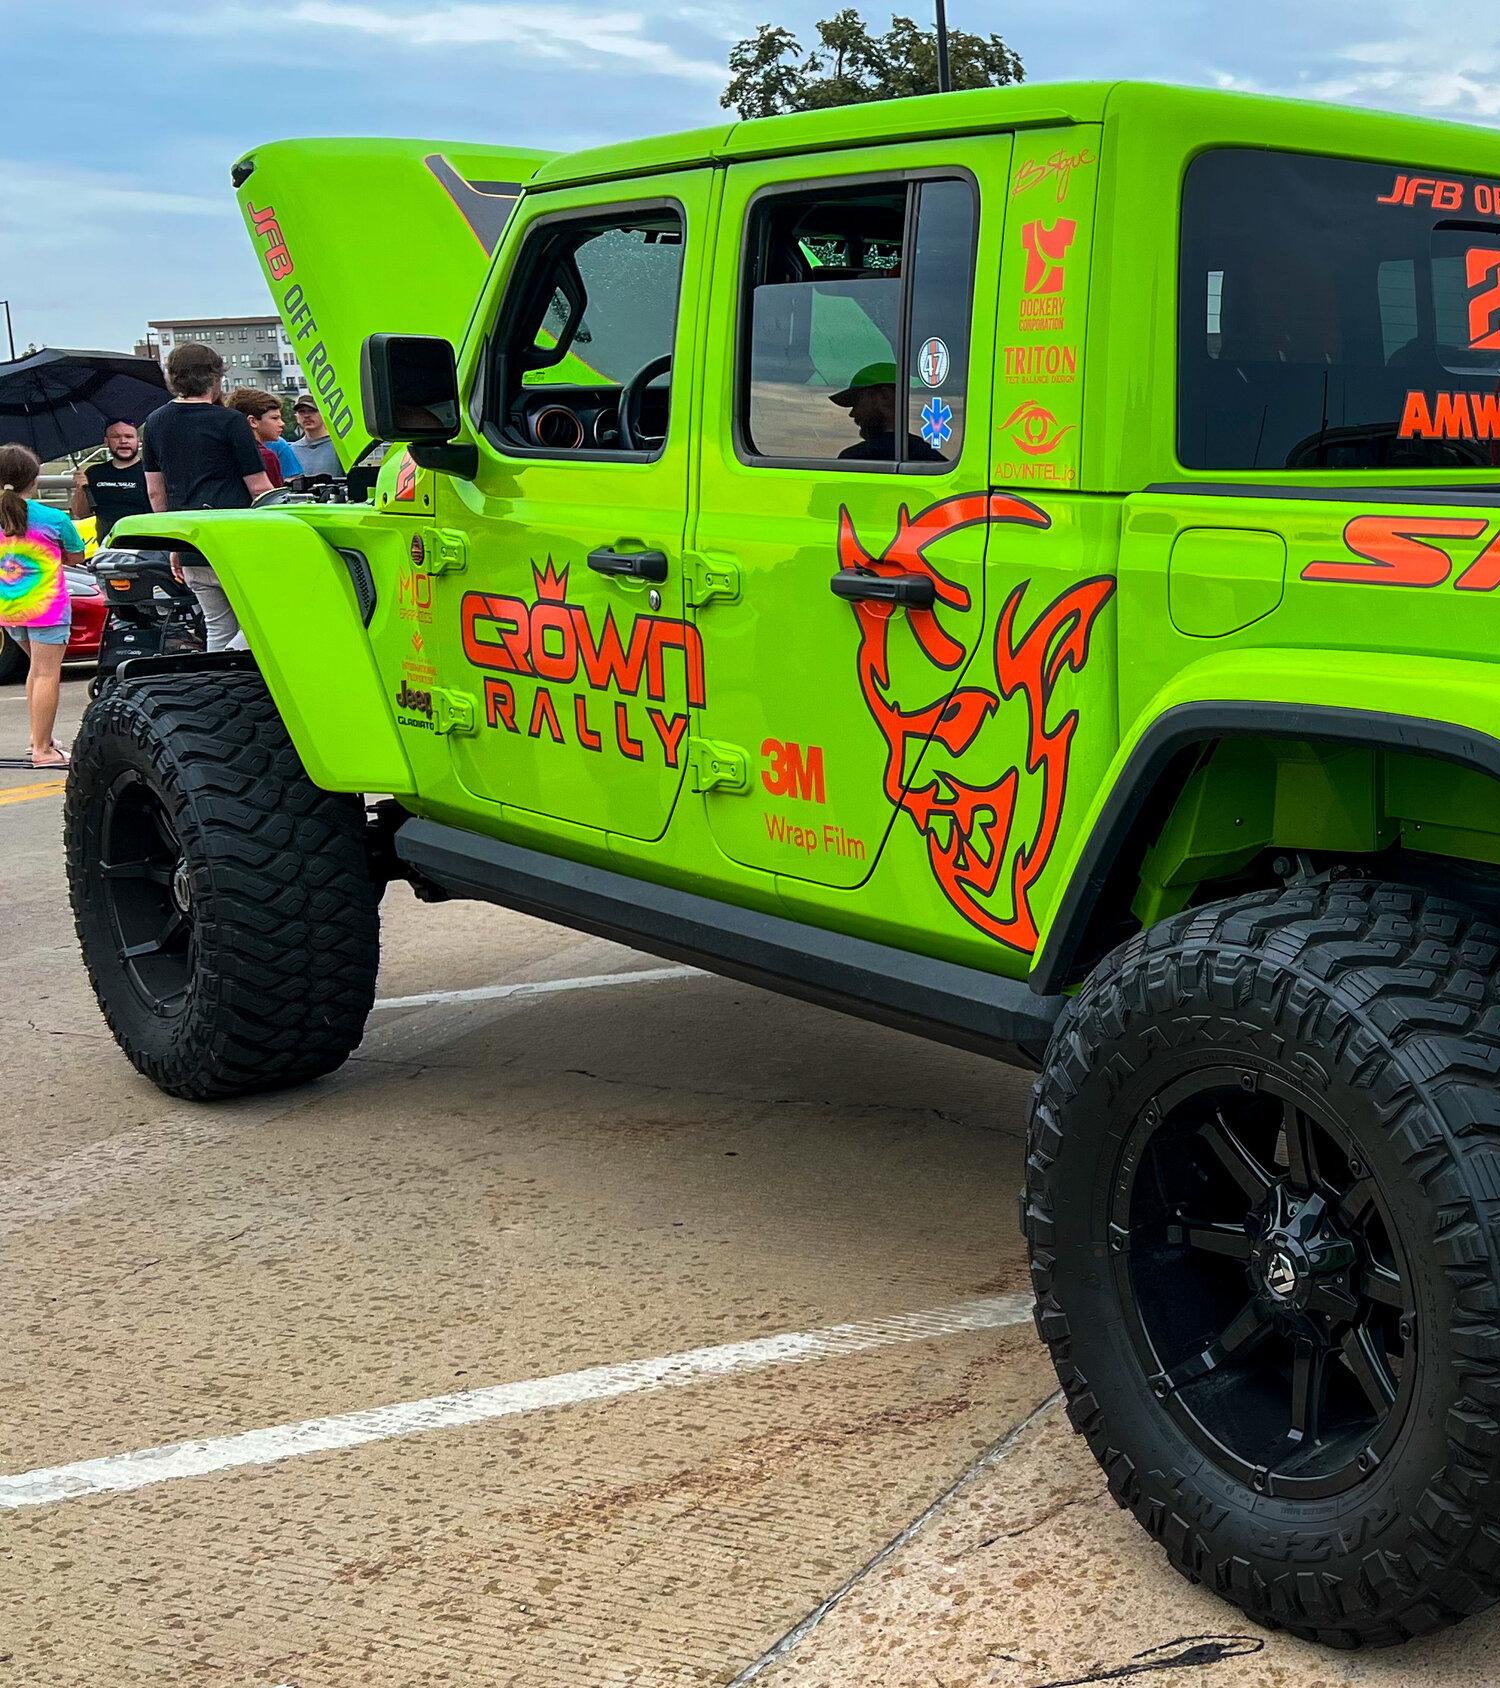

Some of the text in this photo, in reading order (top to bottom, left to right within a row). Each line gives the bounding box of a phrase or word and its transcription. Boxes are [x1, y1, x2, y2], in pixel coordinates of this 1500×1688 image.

[1376, 175, 1464, 211] JFB
[247, 201, 354, 440] JFB OFF ROAD
[1019, 297, 1066, 317] DOCKERY
[923, 352, 944, 376] 47
[1003, 345, 1078, 375] TRITON
[460, 590, 706, 709] CROWN
[396, 680, 433, 721] Jeep
[483, 676, 691, 769] RALLY
[761, 737, 826, 804] 3M
[764, 812, 866, 860] Wrap Film
[1096, 1014, 1332, 1108] MAXXIS
